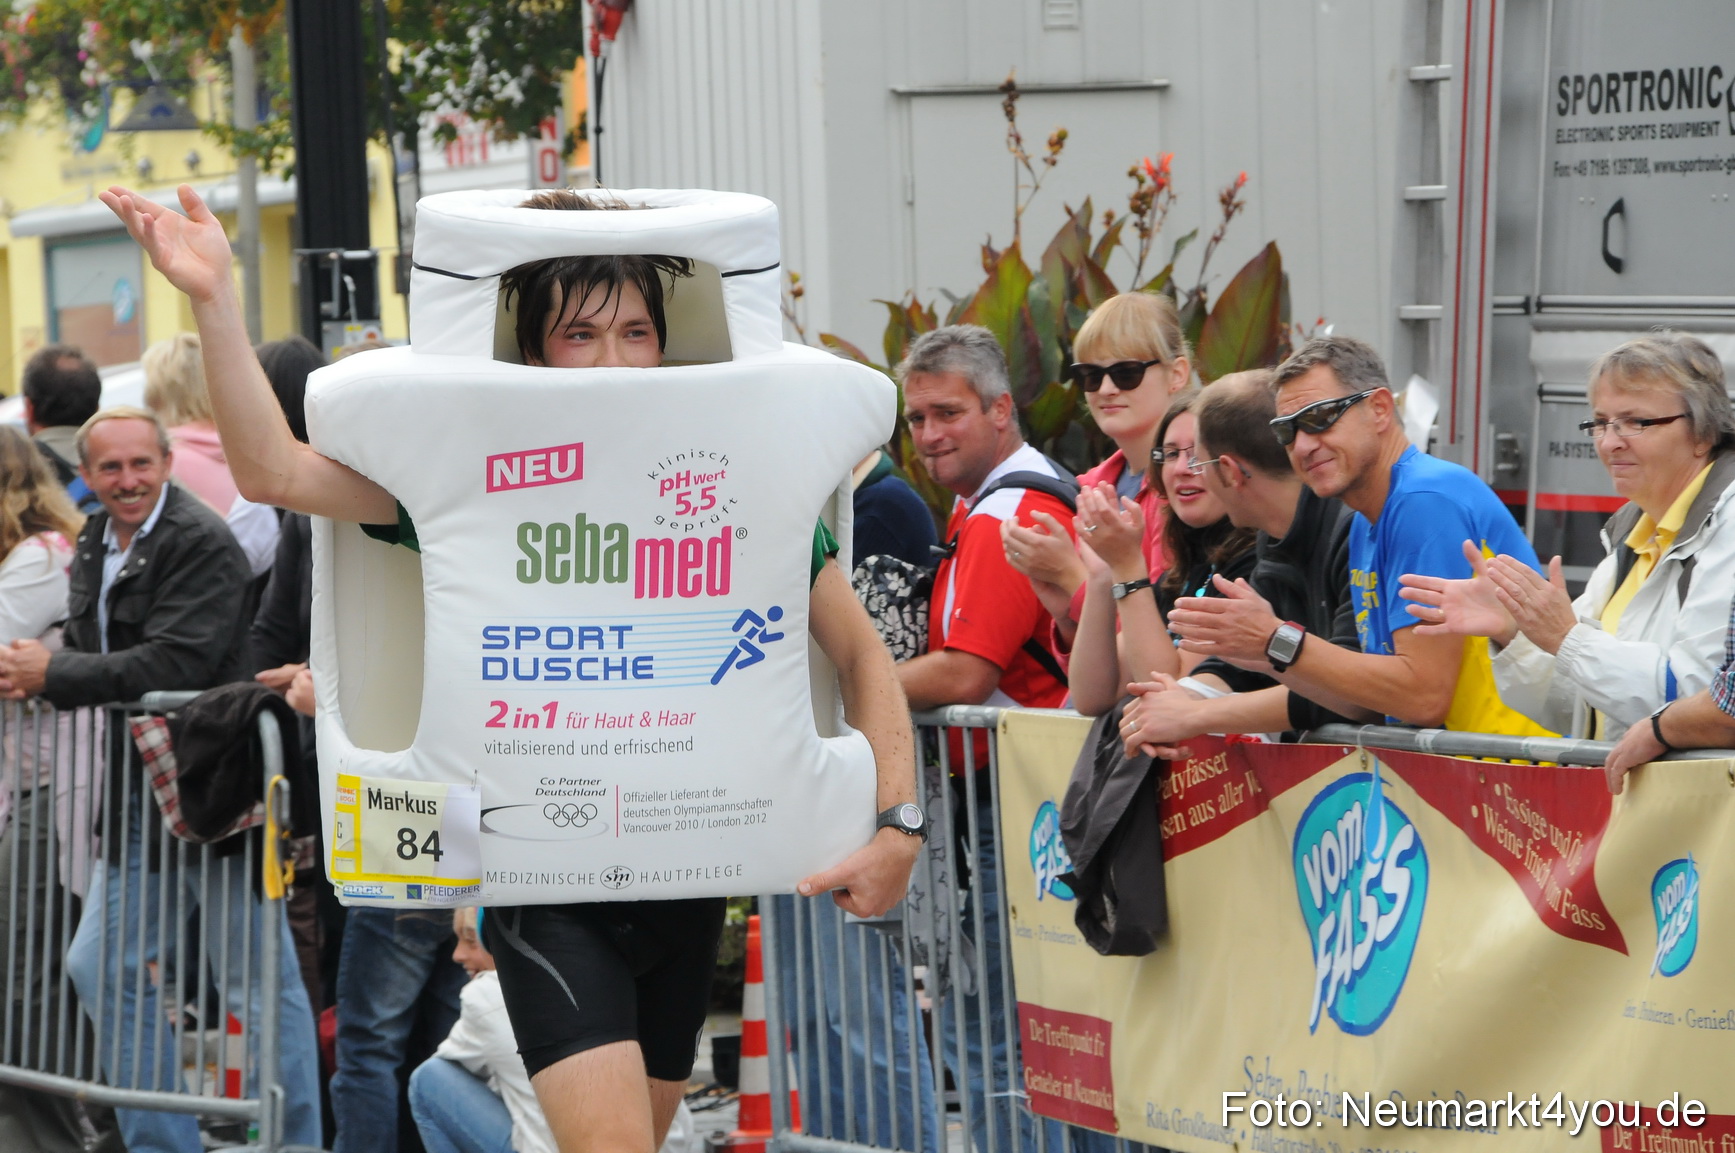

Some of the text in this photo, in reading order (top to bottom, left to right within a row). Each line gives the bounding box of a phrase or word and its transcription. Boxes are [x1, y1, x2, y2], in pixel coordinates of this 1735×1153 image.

[1556, 65, 1723, 117] SPORTRONIC
[1555, 120, 1720, 144] ELECTRONIC SPORTS EQUIPMENT
[1549, 441, 1598, 459] PA-SYSTE
[492, 448, 578, 488] NEU
[647, 448, 730, 481] klinisch
[659, 469, 726, 497] pH Wert
[655, 497, 738, 532] geprüft
[674, 485, 717, 516] 5,5
[482, 625, 633, 650] SPORT
[482, 655, 654, 681] DUSCHE
[566, 711, 589, 729] für
[594, 711, 634, 729] Haut
[639, 711, 652, 728] &
[658, 709, 696, 728] Haar
[484, 736, 693, 755] vitalisierend und erfrischend
[534, 788, 607, 798] Deutschland
[540, 777, 602, 787] Co Partner
[622, 787, 727, 803] Offizieller Lieferant der
[367, 787, 437, 815] Markus
[623, 798, 773, 819] deutschen Olympiamannschaften
[1188, 799, 1217, 827] aus
[1218, 781, 1244, 814] aller
[1503, 782, 1547, 840] Essige
[623, 822, 672, 834] Vancouver
[675, 819, 699, 831] 2010
[708, 816, 741, 829] London
[744, 812, 767, 825] 2012
[396, 827, 444, 863] 84
[1303, 799, 1363, 910] vom
[486, 870, 596, 885] MEDIZINISCHE
[640, 864, 743, 884] HAUTPFLEGE
[1482, 803, 1524, 859] Weine
[1561, 888, 1606, 931] Fass
[423, 884, 481, 897] PFLEIDERER
[1309, 823, 1414, 1036] FASS
[1146, 1102, 1169, 1131] Rita
[1613, 1122, 1633, 1151] Der
